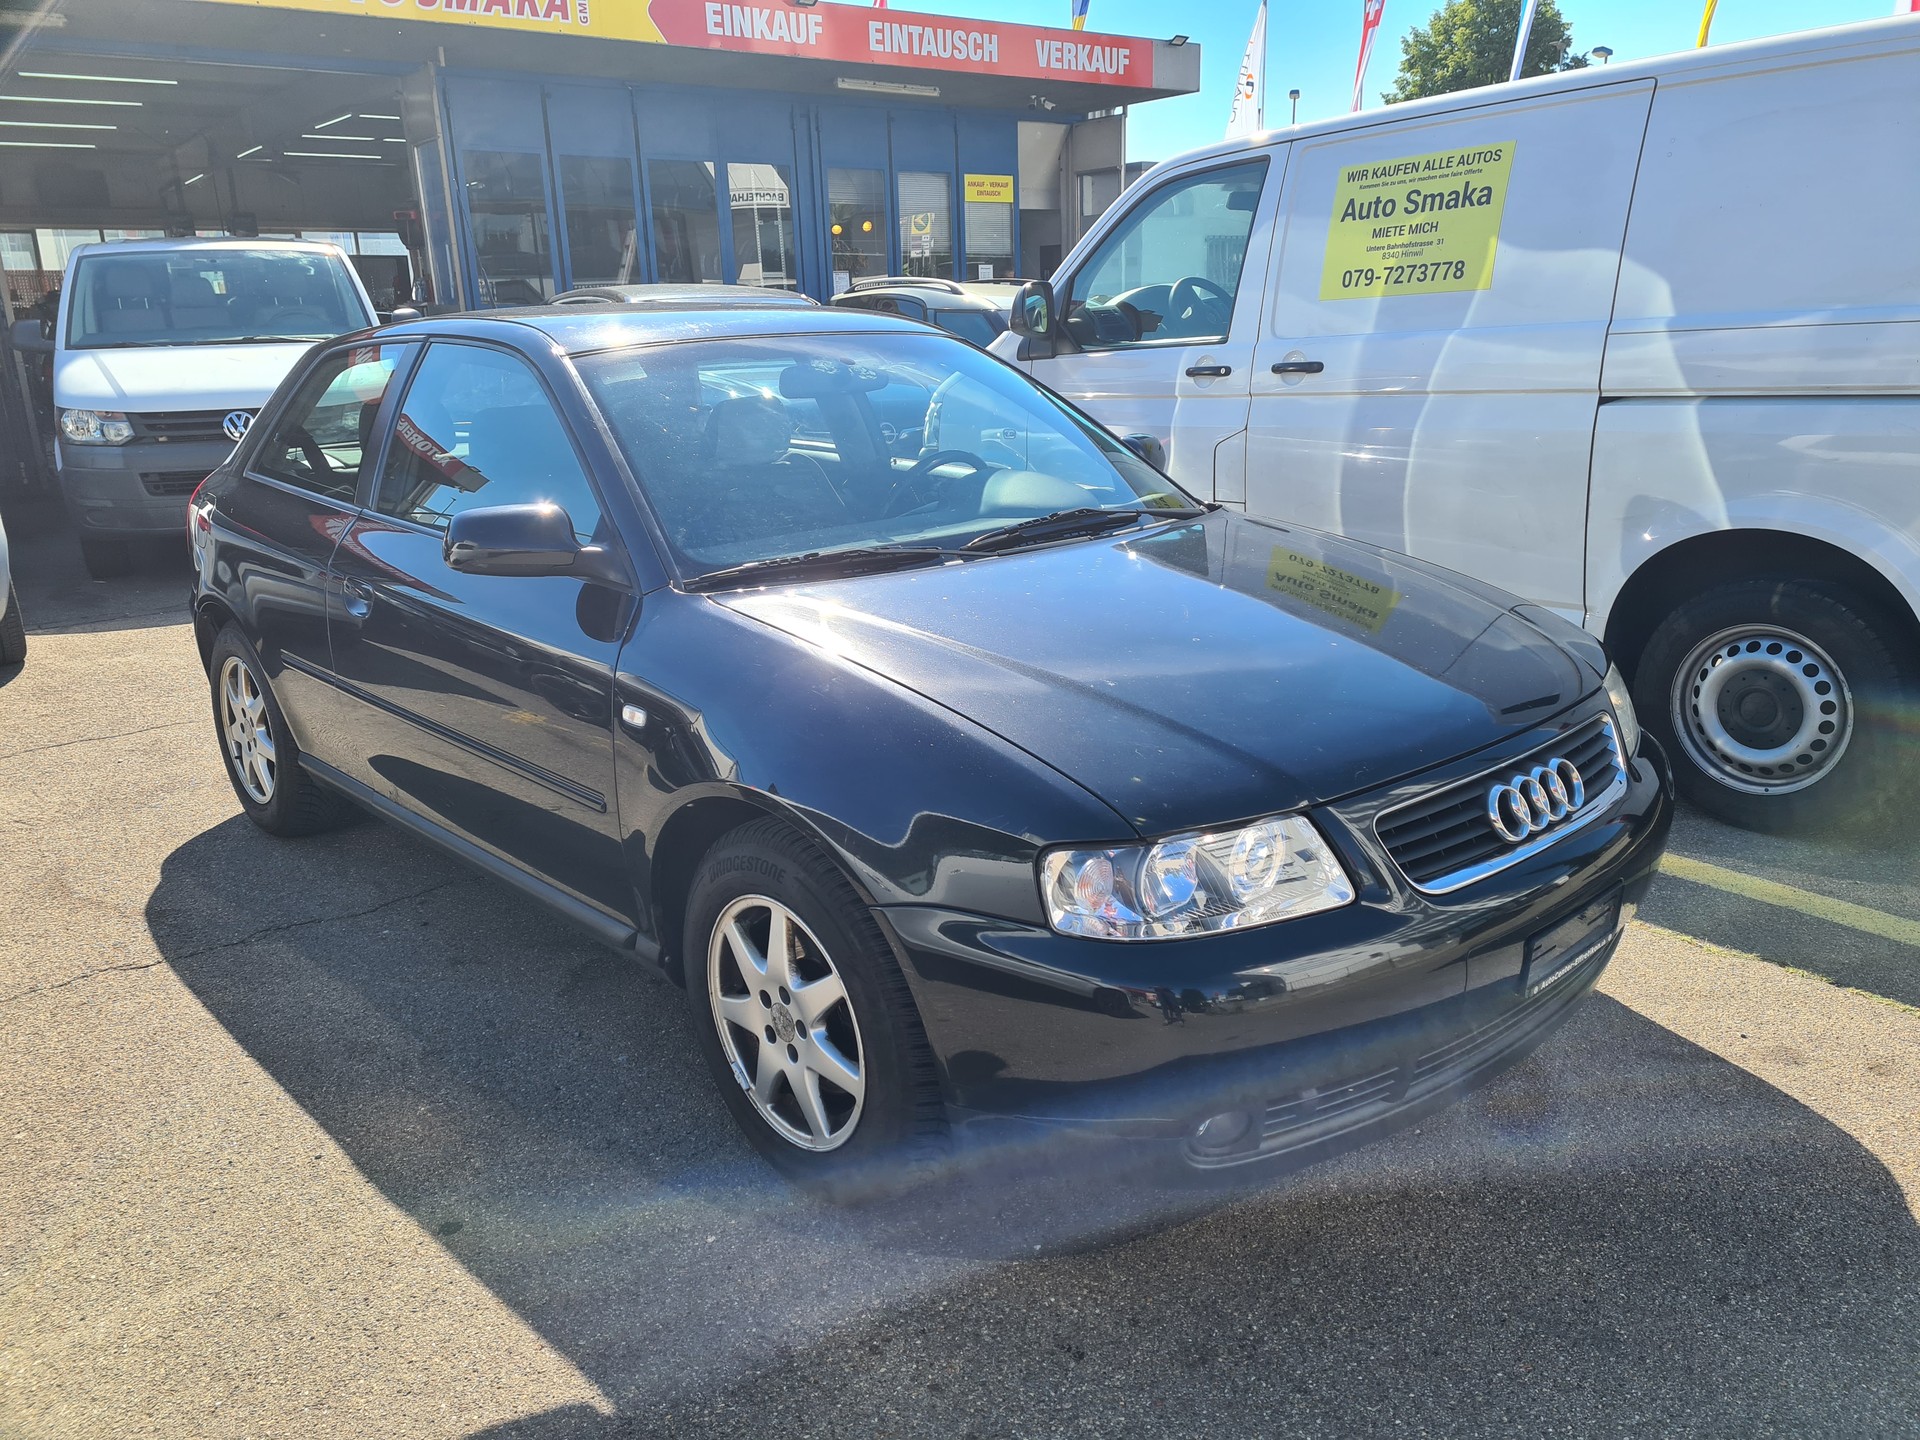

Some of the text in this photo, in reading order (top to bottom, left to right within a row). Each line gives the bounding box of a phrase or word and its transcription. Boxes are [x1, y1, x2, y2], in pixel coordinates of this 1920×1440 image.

[578, 0, 588, 24] GM
[705, 2, 1130, 75] EINKAUF EINTAUSCH VERKAUF
[1347, 149, 1502, 183] WIR KAUFEN ALLE AUTOS
[1417, 174, 1438, 182] machen
[1450, 170, 1463, 178] faire
[1340, 181, 1493, 223] Auto Smaka
[1372, 221, 1439, 239] MIETE MICH
[1382, 248, 1423, 260] 8340 Hinwil
[1386, 239, 1434, 250] Bahnhofstrasse
[1436, 238, 1445, 246] 31
[1342, 260, 1466, 288] 079-7273778
[708, 856, 786, 884] BRIDGESTONE
